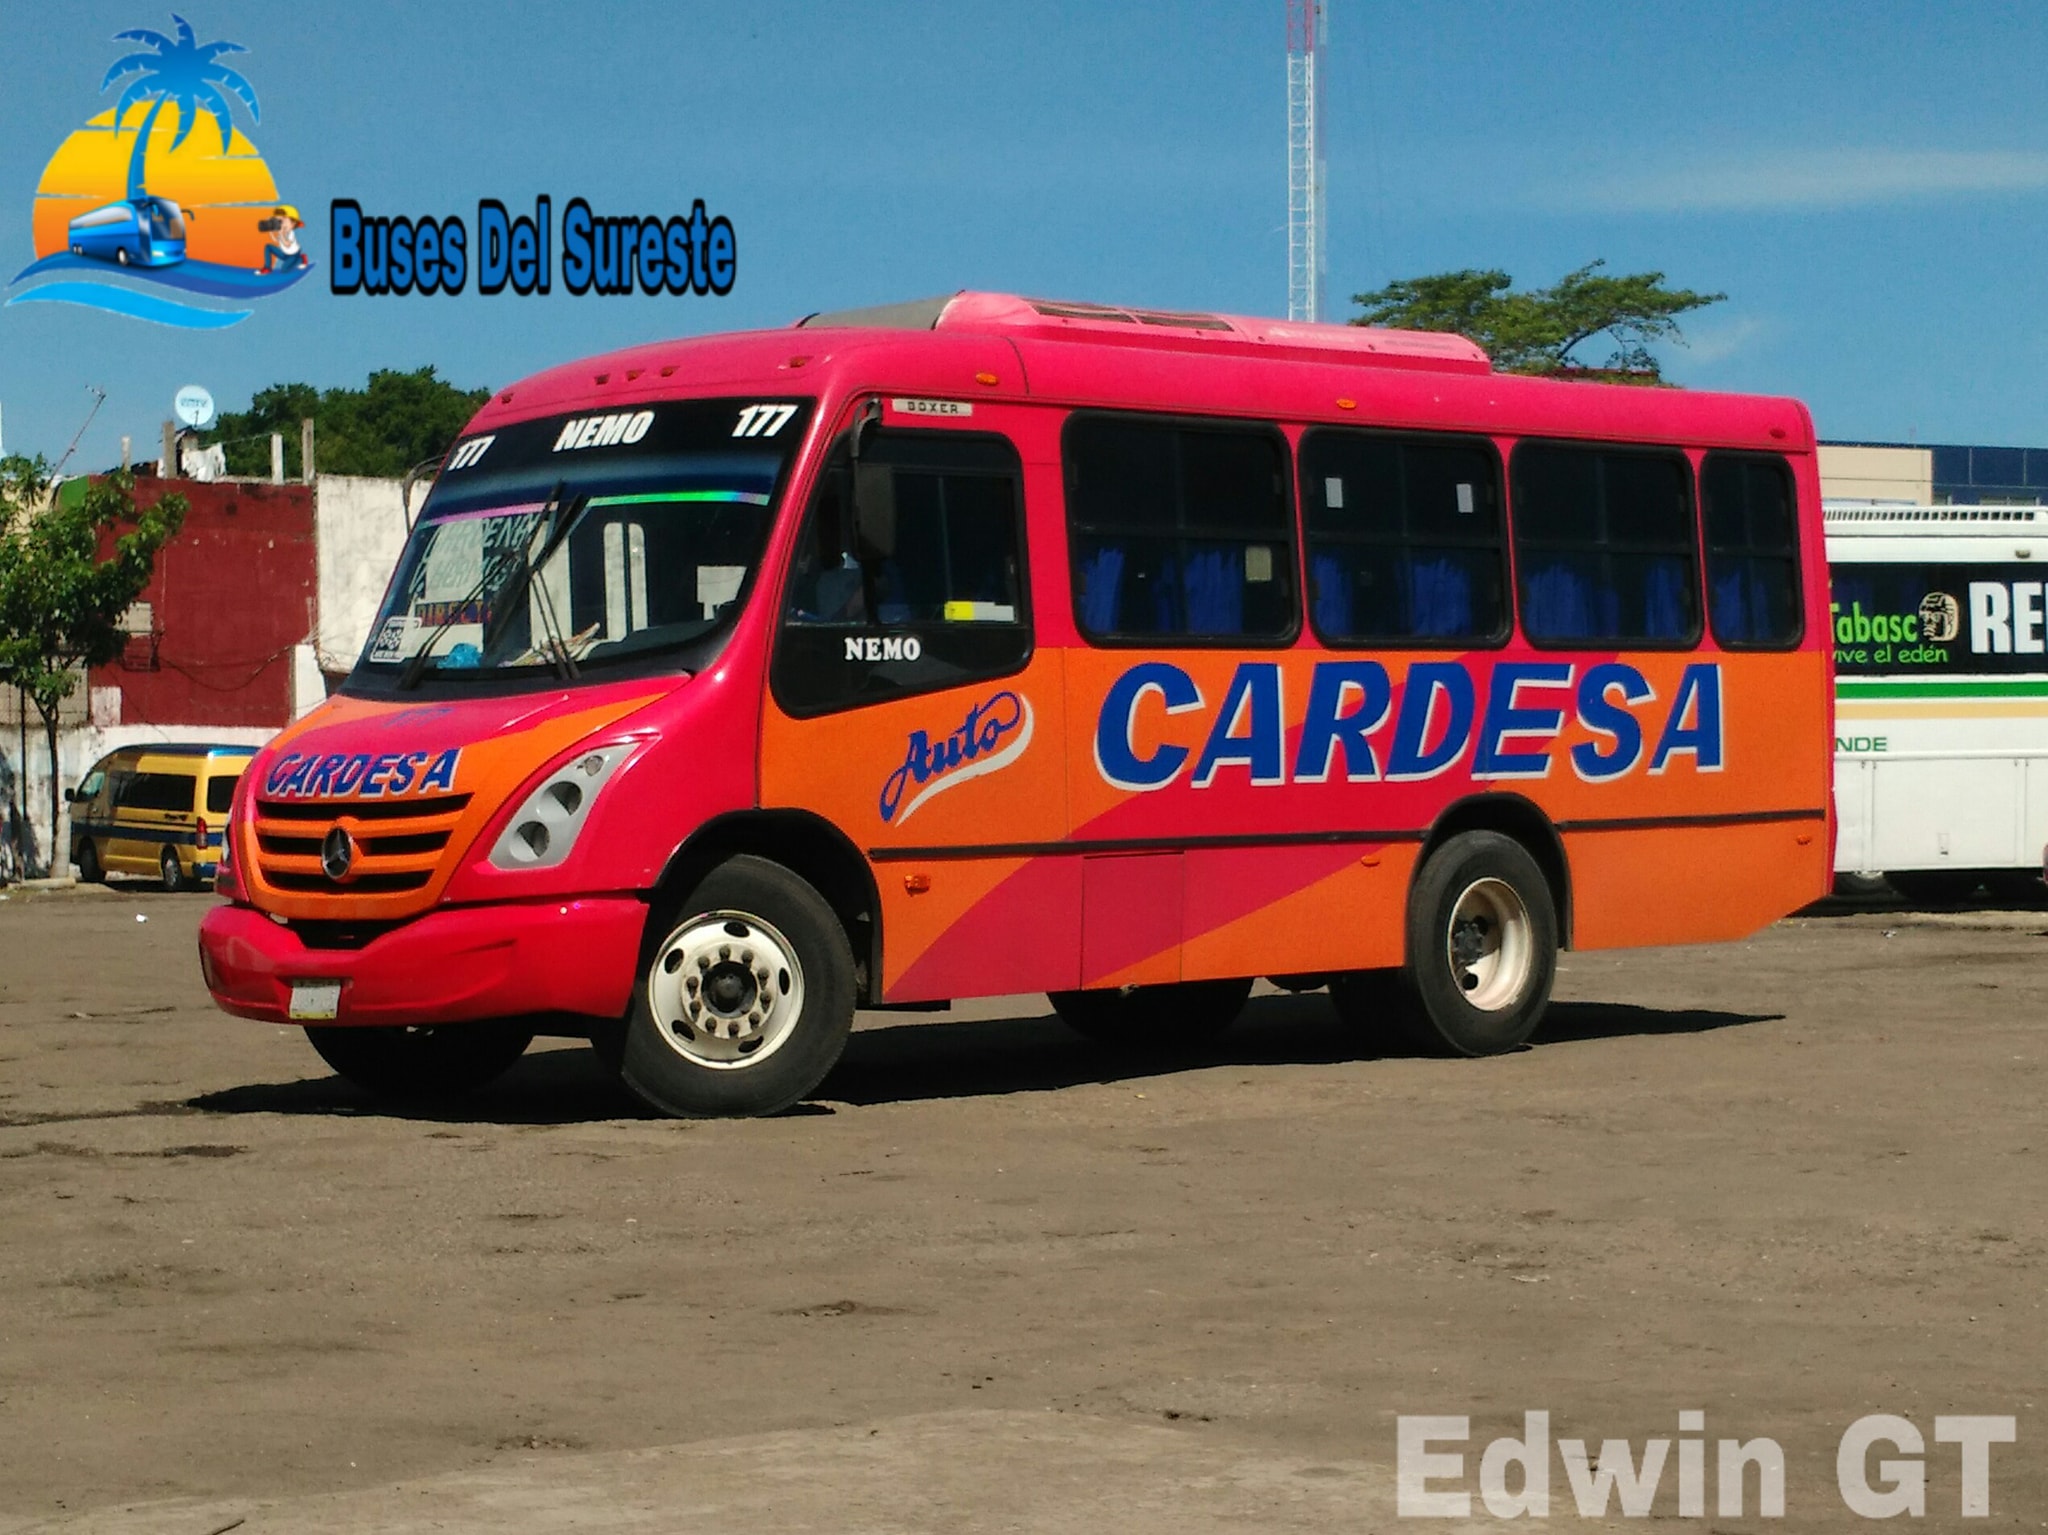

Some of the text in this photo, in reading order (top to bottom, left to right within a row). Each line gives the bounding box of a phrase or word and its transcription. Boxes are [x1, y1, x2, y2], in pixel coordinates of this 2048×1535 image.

[731, 403, 799, 439] 177
[907, 400, 958, 414] BOXER
[553, 410, 656, 453] NEMO
[448, 434, 496, 472] 177
[1968, 581, 2048, 654] RE
[843, 636, 921, 662] NEMO
[1873, 644, 1892, 664] el
[1899, 644, 1948, 664] edén
[1094, 661, 1724, 791] CARDESA
[265, 747, 463, 798] CARDESA
[879, 691, 1021, 822] Auto
